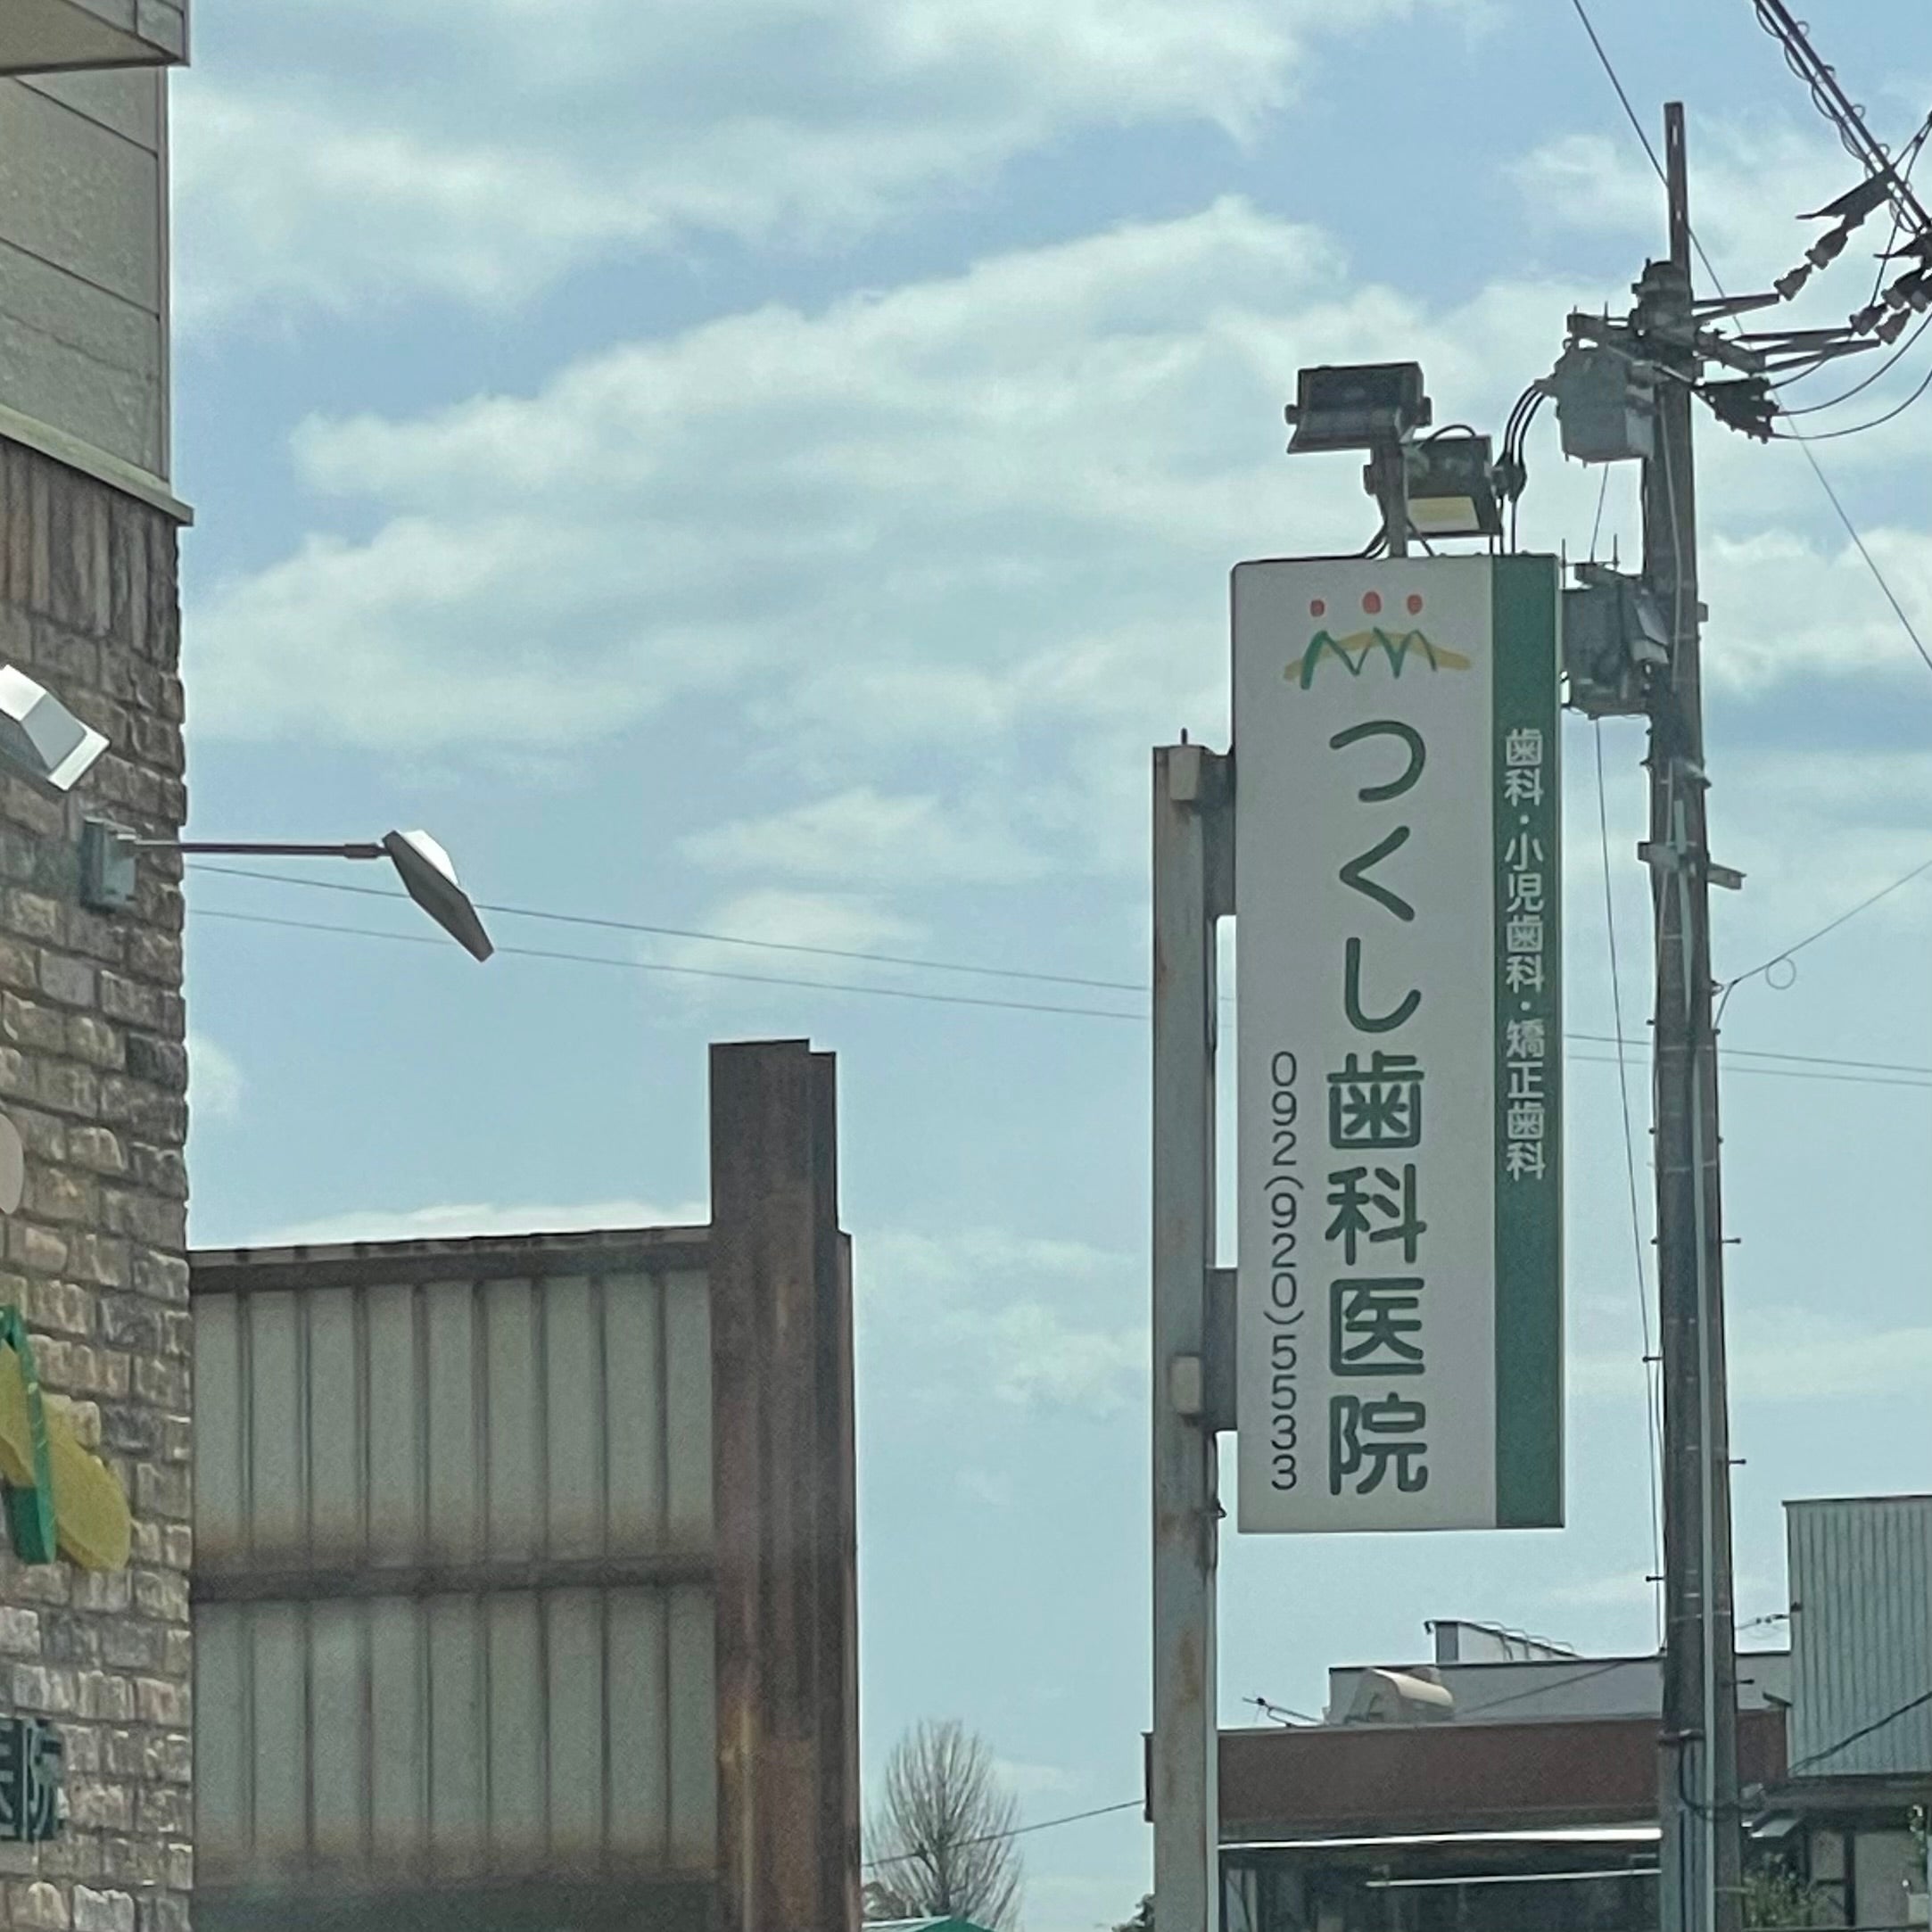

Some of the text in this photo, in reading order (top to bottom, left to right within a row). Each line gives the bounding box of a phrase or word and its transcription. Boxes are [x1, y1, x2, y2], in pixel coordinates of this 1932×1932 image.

[1325, 720, 1428, 1496] つくし歯科医院
[1505, 728, 1545, 1181] 歯科・小児歯科・矯正歯科
[1264, 1051, 1305, 1490] 092(920)5533
